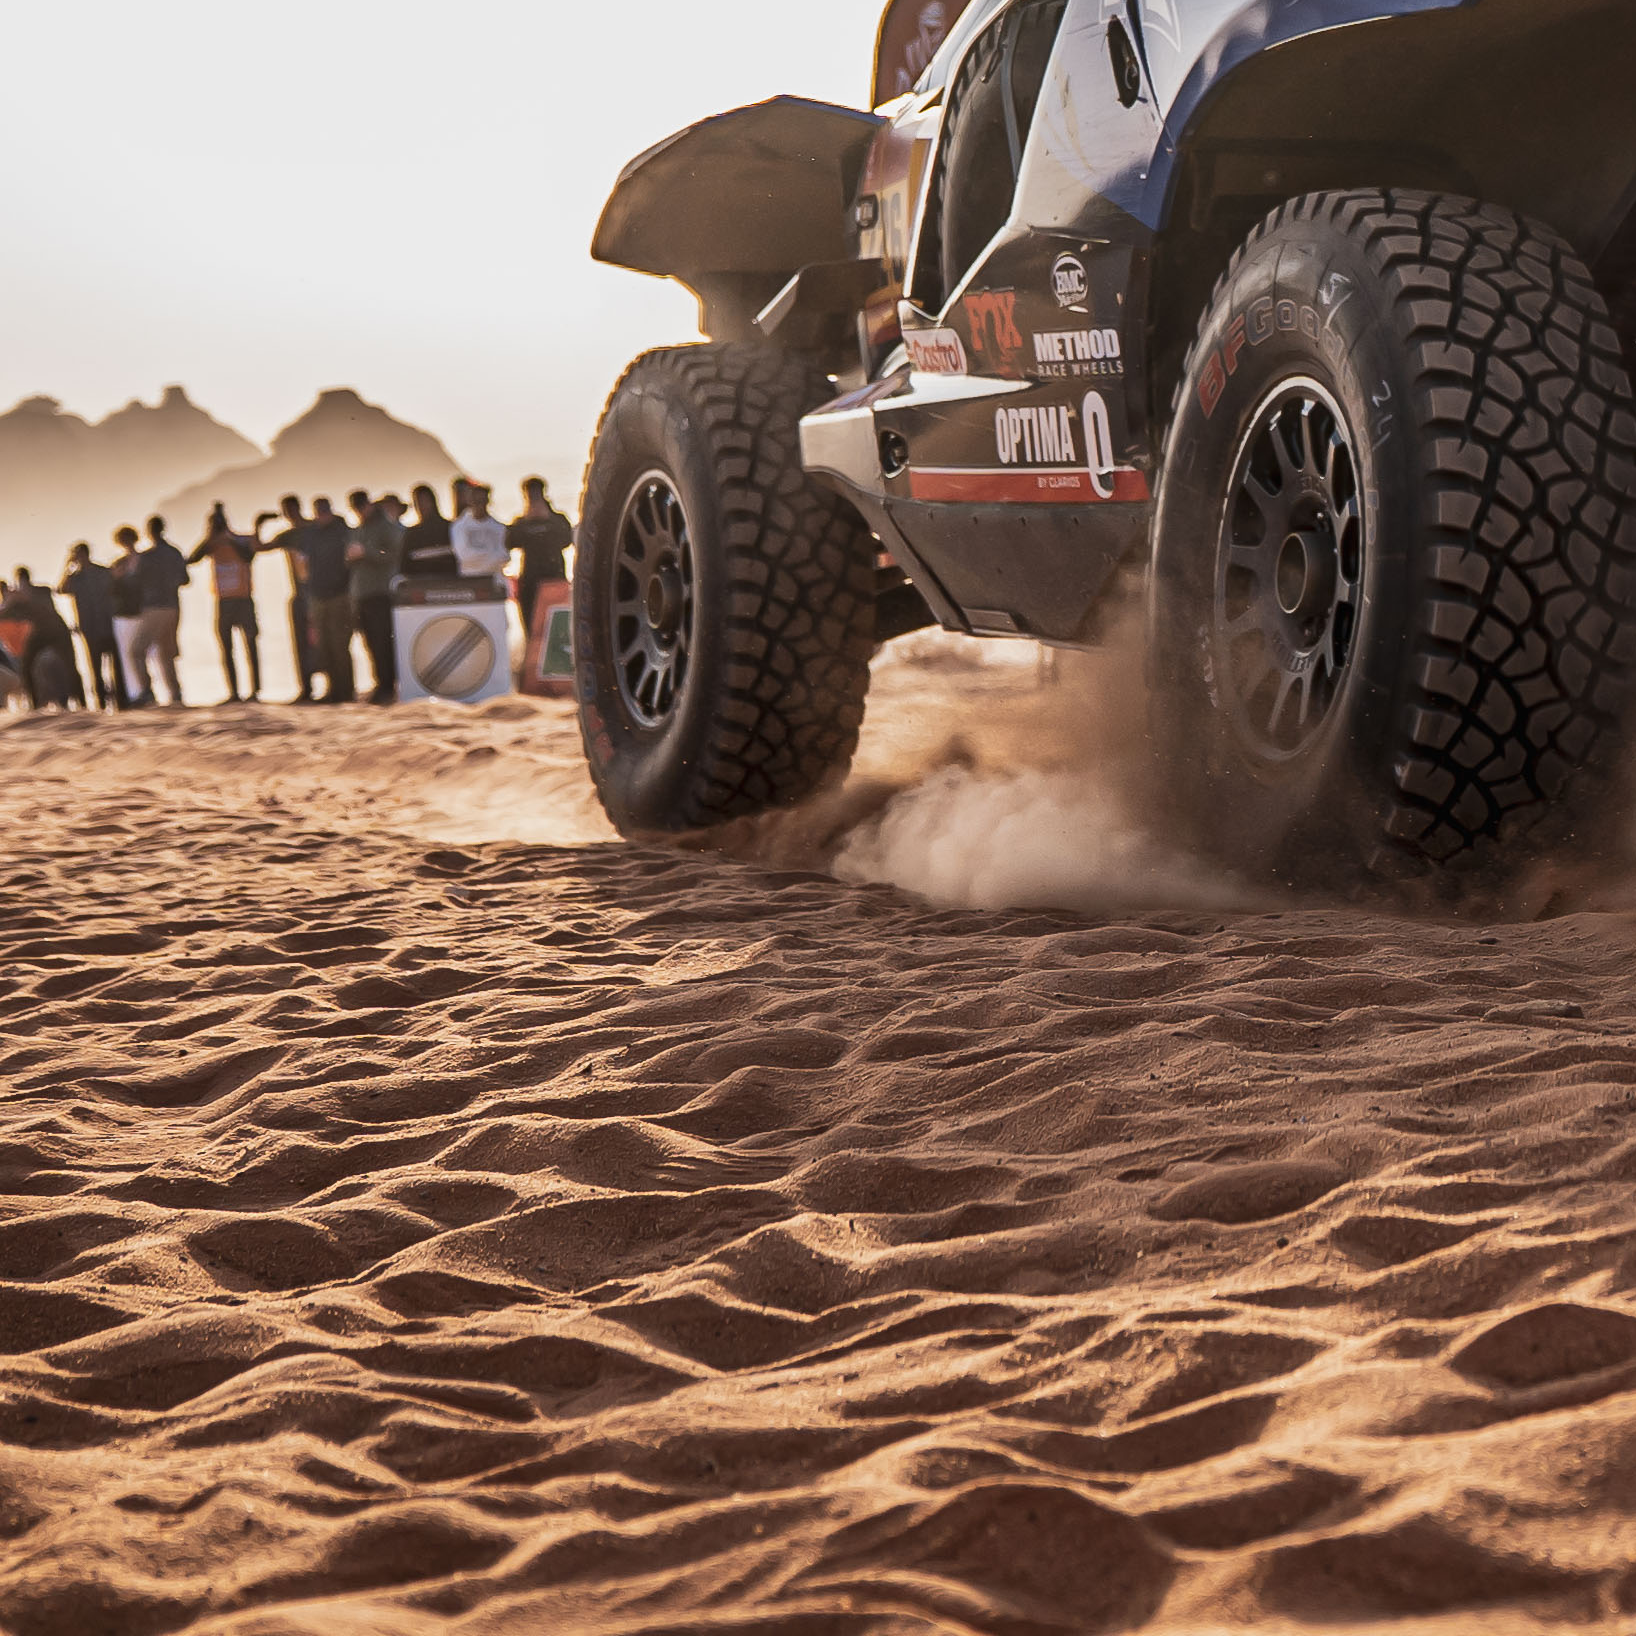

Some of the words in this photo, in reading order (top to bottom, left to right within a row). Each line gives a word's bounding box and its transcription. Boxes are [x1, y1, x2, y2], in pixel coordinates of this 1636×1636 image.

[1055, 270, 1085, 294] BMC
[911, 335, 964, 372] Castrol
[1032, 329, 1121, 362] METHOD
[1037, 363, 1068, 378] RACE
[1072, 360, 1124, 376] WHEELS
[995, 405, 1076, 465] OPTIMA
